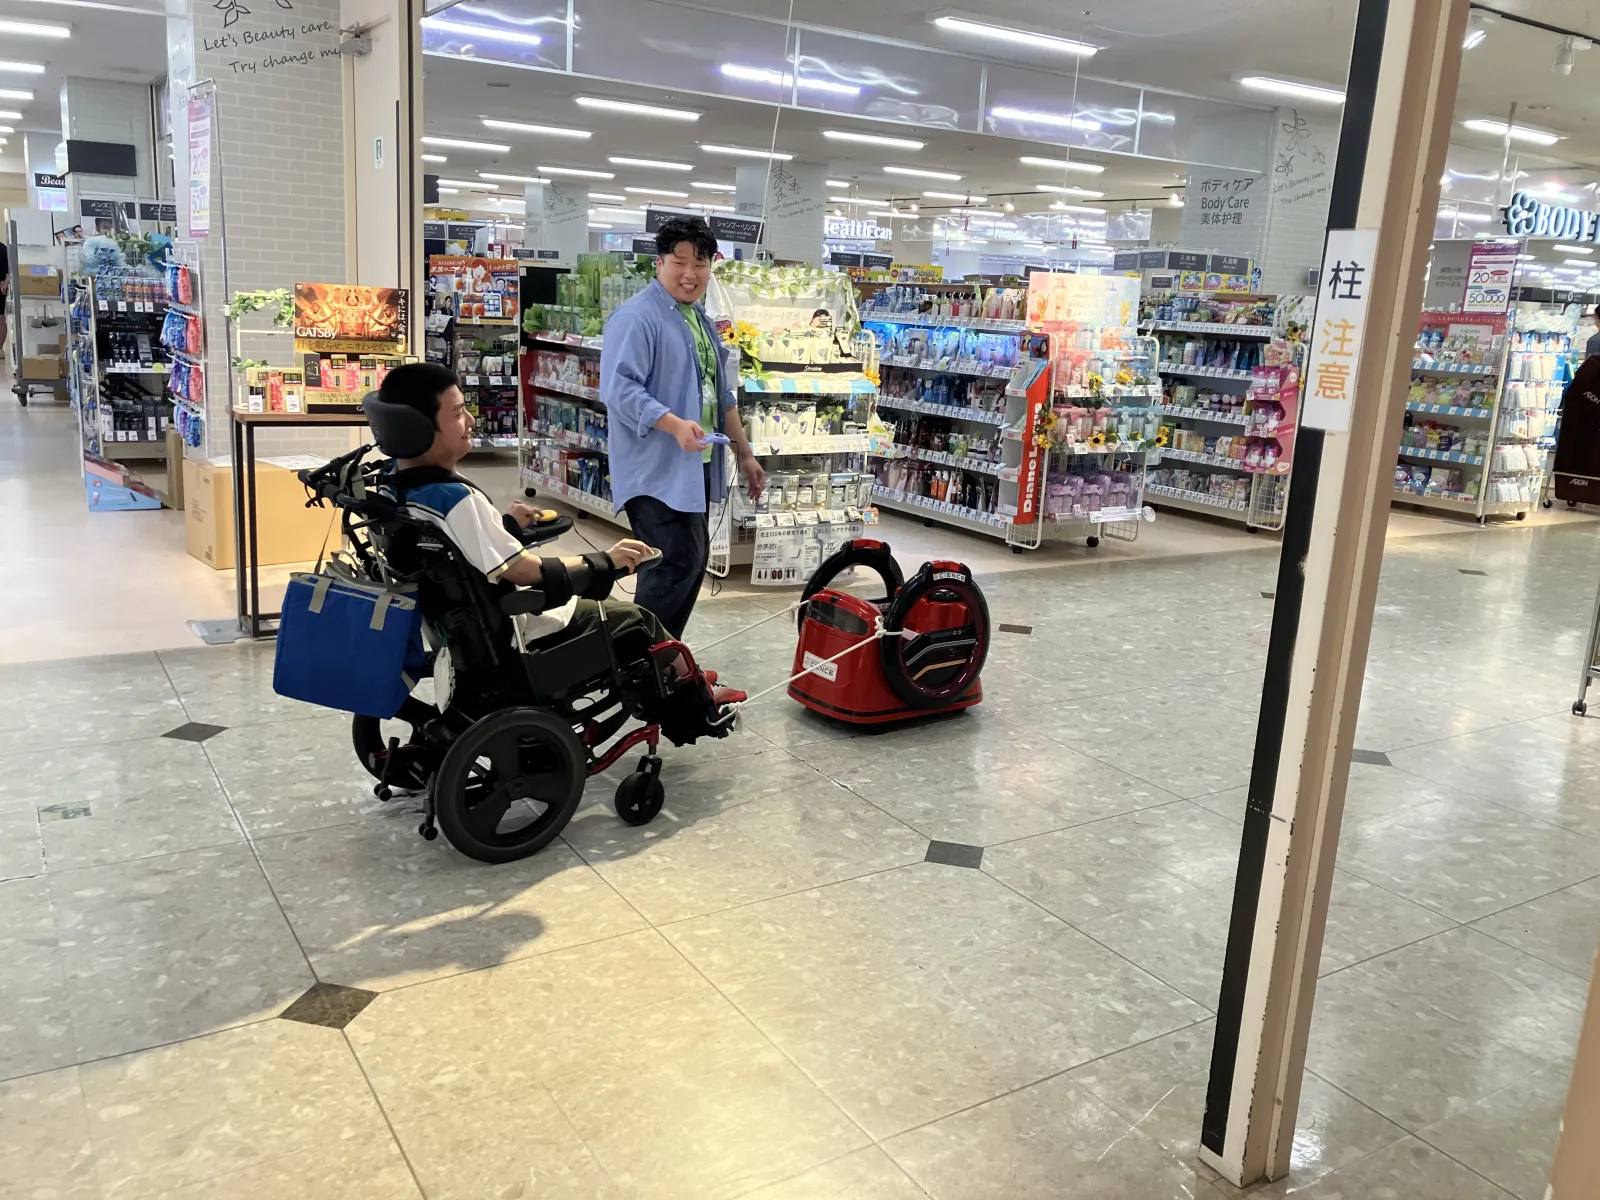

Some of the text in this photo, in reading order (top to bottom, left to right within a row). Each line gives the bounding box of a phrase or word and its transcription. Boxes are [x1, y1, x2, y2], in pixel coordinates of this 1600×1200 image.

[204, 21, 334, 51] Let's Beauty care.
[228, 61, 257, 74] Try
[263, 50, 316, 68] change
[1200, 178, 1254, 193] ボディケア
[1201, 196, 1250, 212] Body Care
[1201, 212, 1243, 226] 美体护理
[1534, 203, 1595, 242] BODY
[1469, 293, 1505, 304] 50,000
[1314, 260, 1365, 399] 柱 注意
